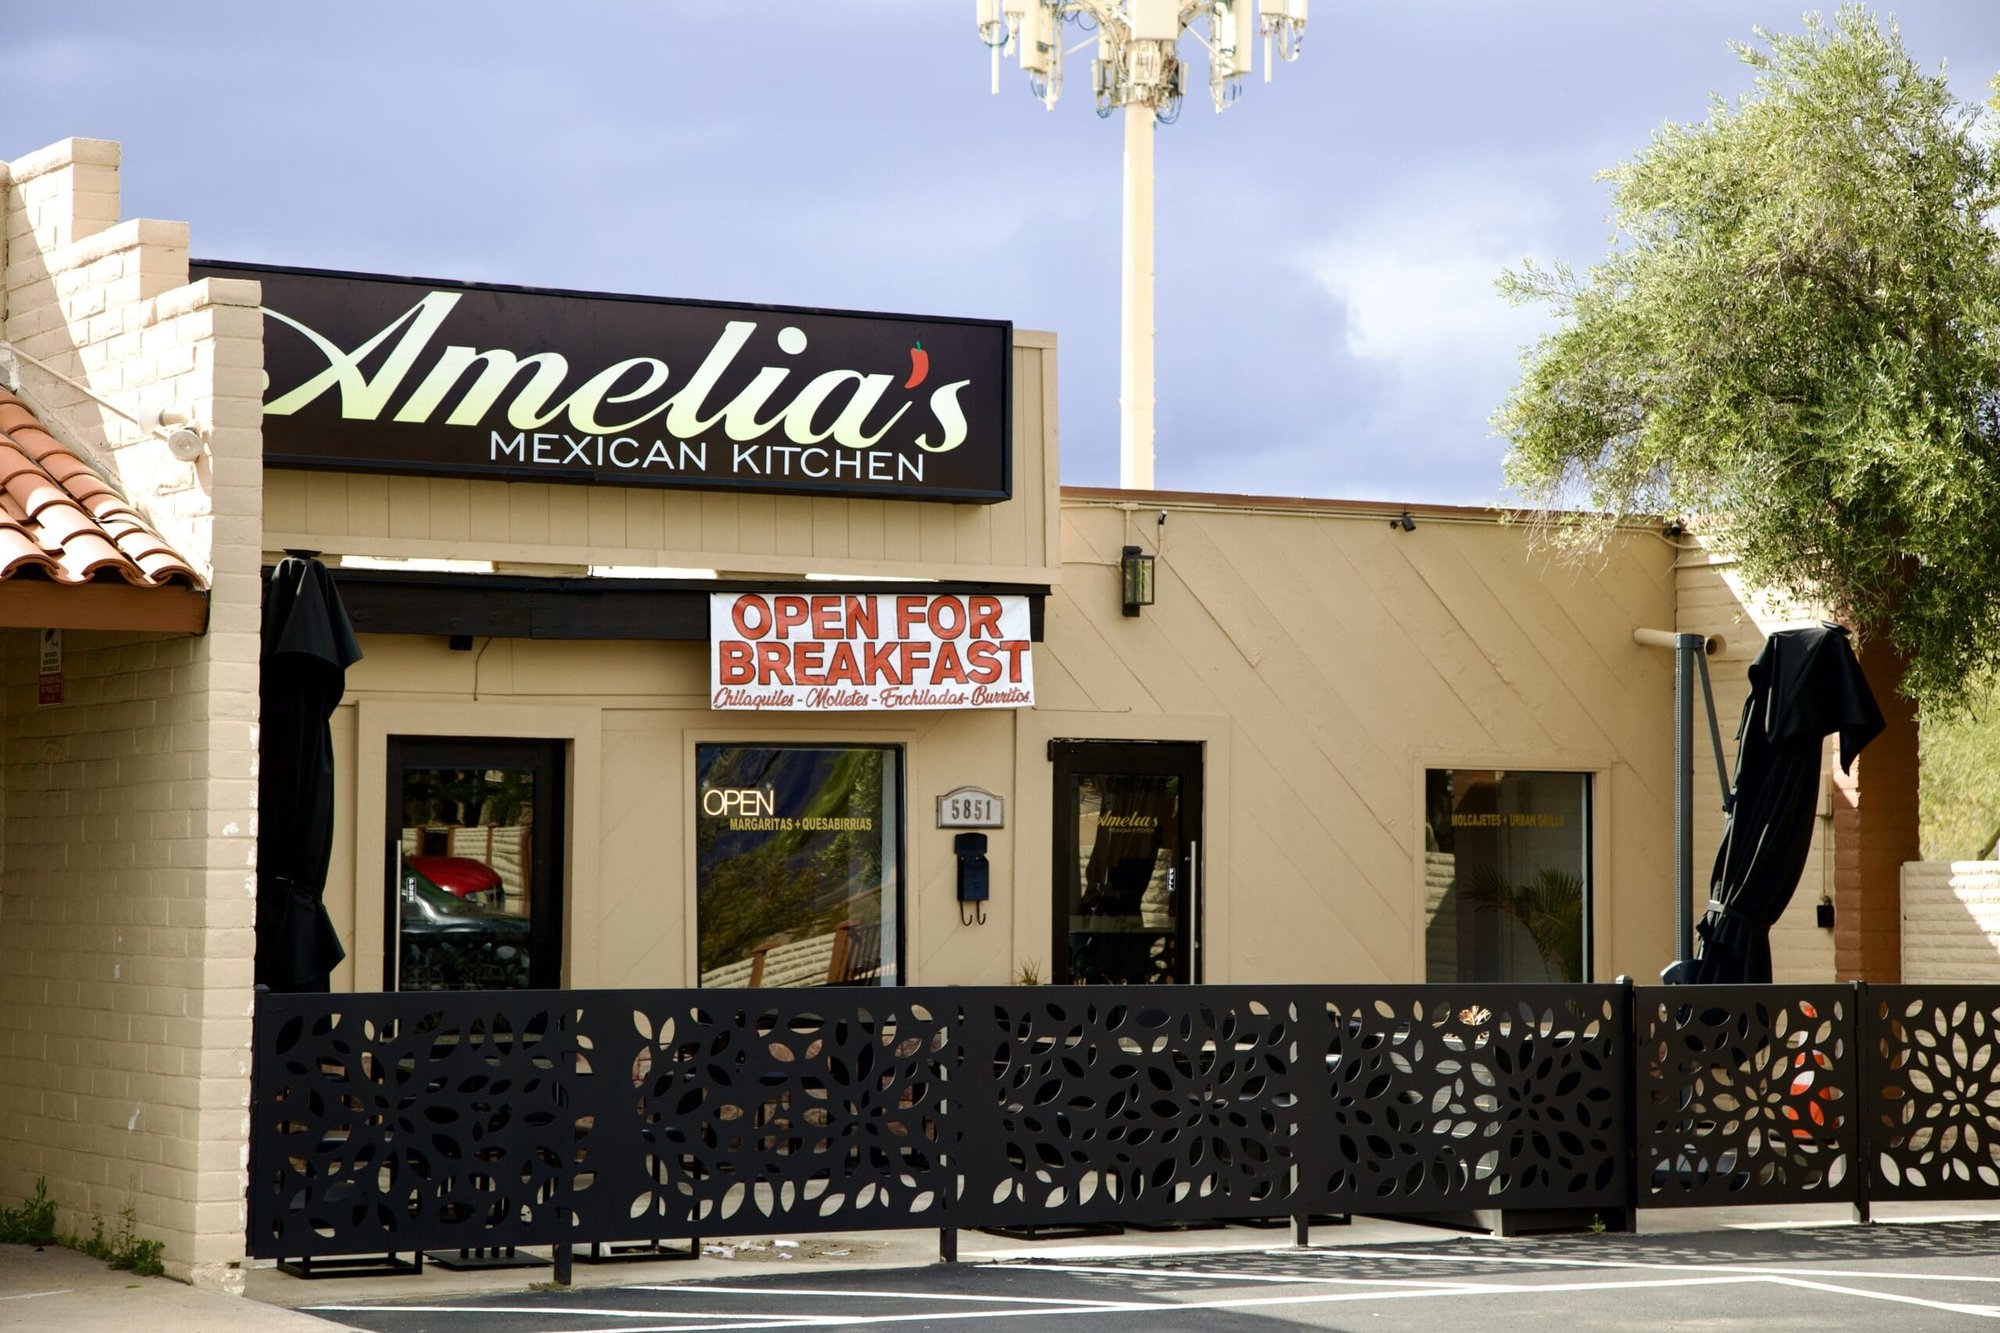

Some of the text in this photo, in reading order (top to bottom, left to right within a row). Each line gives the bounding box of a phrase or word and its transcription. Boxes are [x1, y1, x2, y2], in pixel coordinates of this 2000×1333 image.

[263, 291, 970, 452] Amelia's
[489, 430, 924, 482] MEXICAN KITCHEN
[731, 593, 1004, 640] OPEN FOR
[719, 640, 1031, 686] BREAKFAST
[713, 687, 794, 711] Chilaquiles
[805, 686, 868, 709] Molletes
[703, 788, 774, 817] OPEN
[951, 798, 992, 821] 5851
[730, 817, 793, 831] MARGARITAS
[802, 817, 872, 831] QUESABIRRIAS
[1097, 810, 1159, 828] Amelias
[1451, 813, 1501, 827] MOLCAJETES
